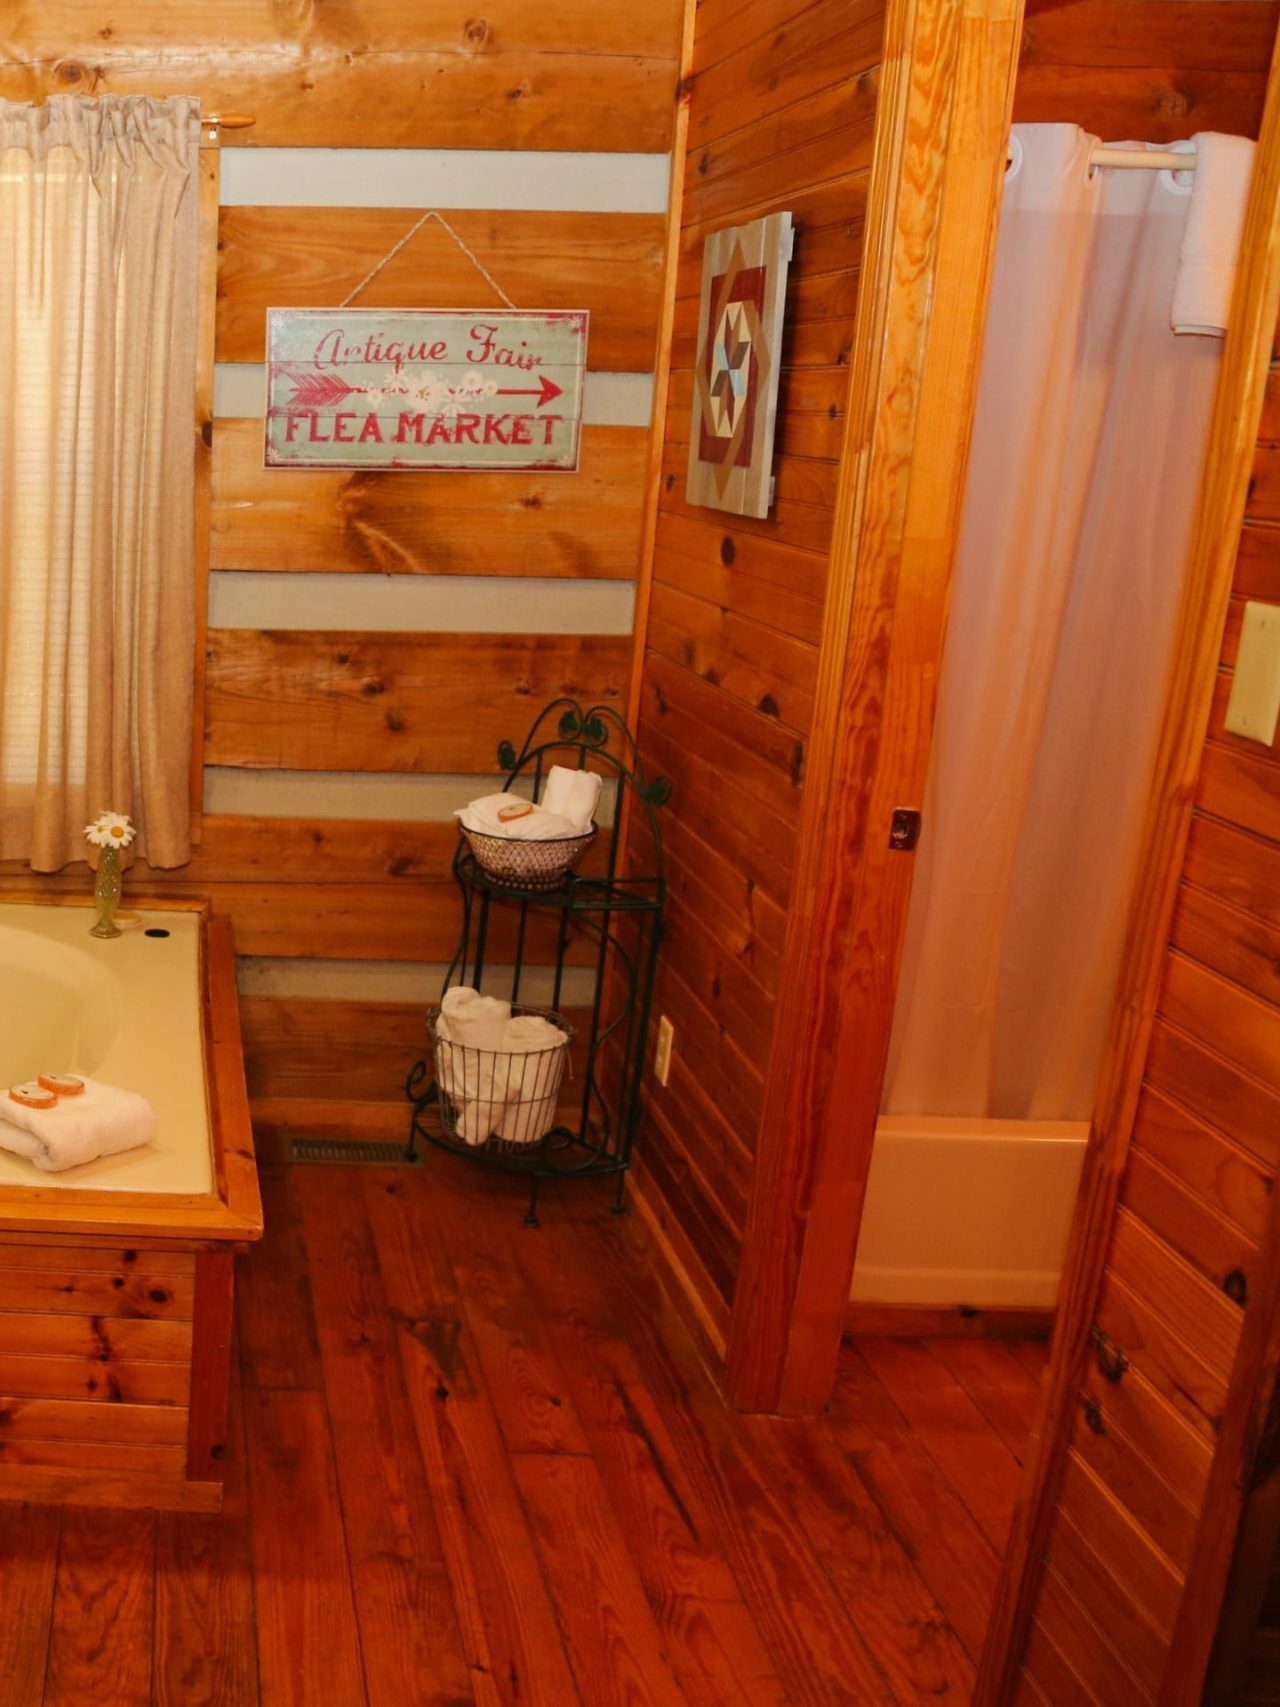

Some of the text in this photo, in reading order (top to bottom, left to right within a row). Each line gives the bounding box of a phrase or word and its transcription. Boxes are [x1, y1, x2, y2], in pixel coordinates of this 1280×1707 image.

[314, 324, 544, 374] Antique Fair
[285, 411, 564, 446] FLEA MARKET
